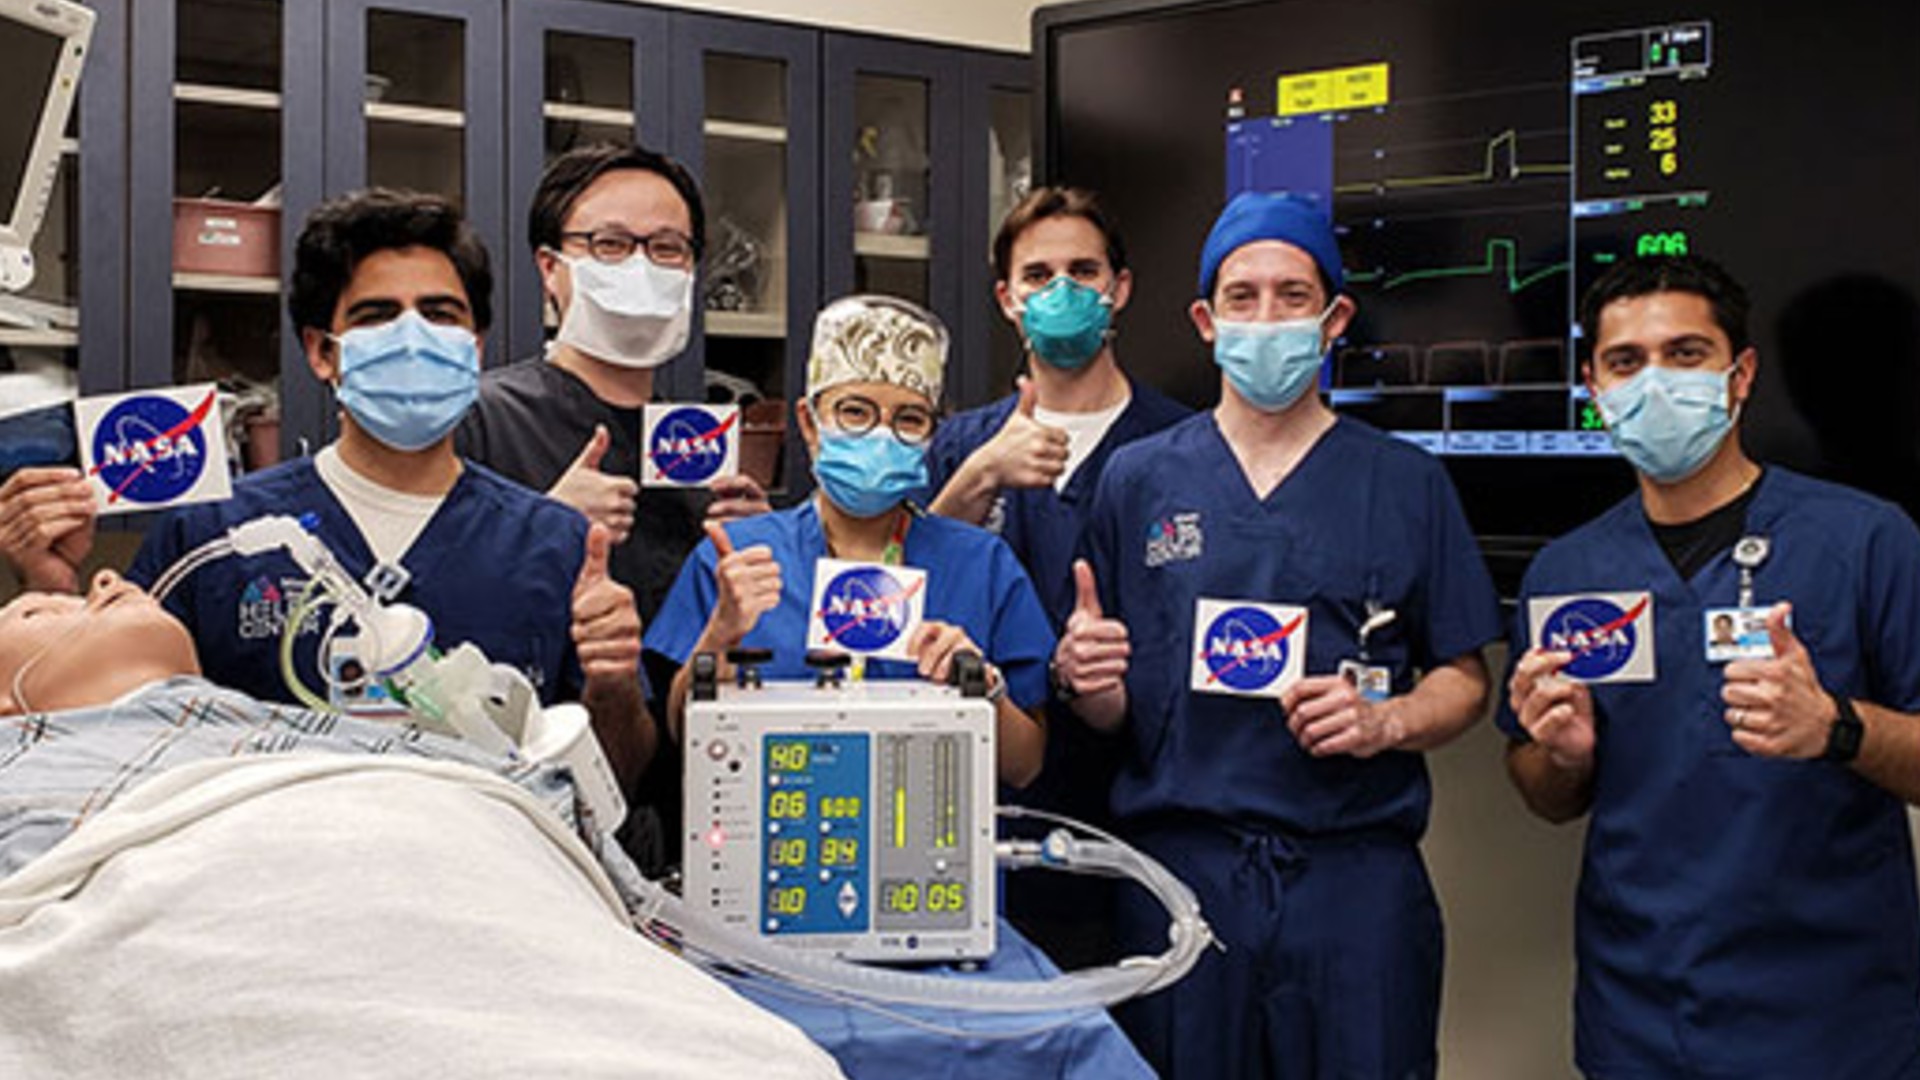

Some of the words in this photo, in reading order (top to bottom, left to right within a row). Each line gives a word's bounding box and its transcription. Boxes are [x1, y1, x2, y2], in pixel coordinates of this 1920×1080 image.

[1650, 100, 1678, 124] 33
[1650, 126, 1678, 151] 25
[1660, 152, 1678, 175] 6
[103, 433, 199, 466] NASA
[659, 437, 722, 456] NASA
[831, 595, 900, 628] NASA
[1210, 635, 1283, 661] NASA
[1551, 628, 1630, 650] NASA
[770, 743, 808, 771] 40
[769, 791, 808, 818] 06
[775, 839, 808, 866] 10
[775, 886, 808, 914] 10
[888, 883, 919, 912] 10
[926, 883, 966, 911] 05
